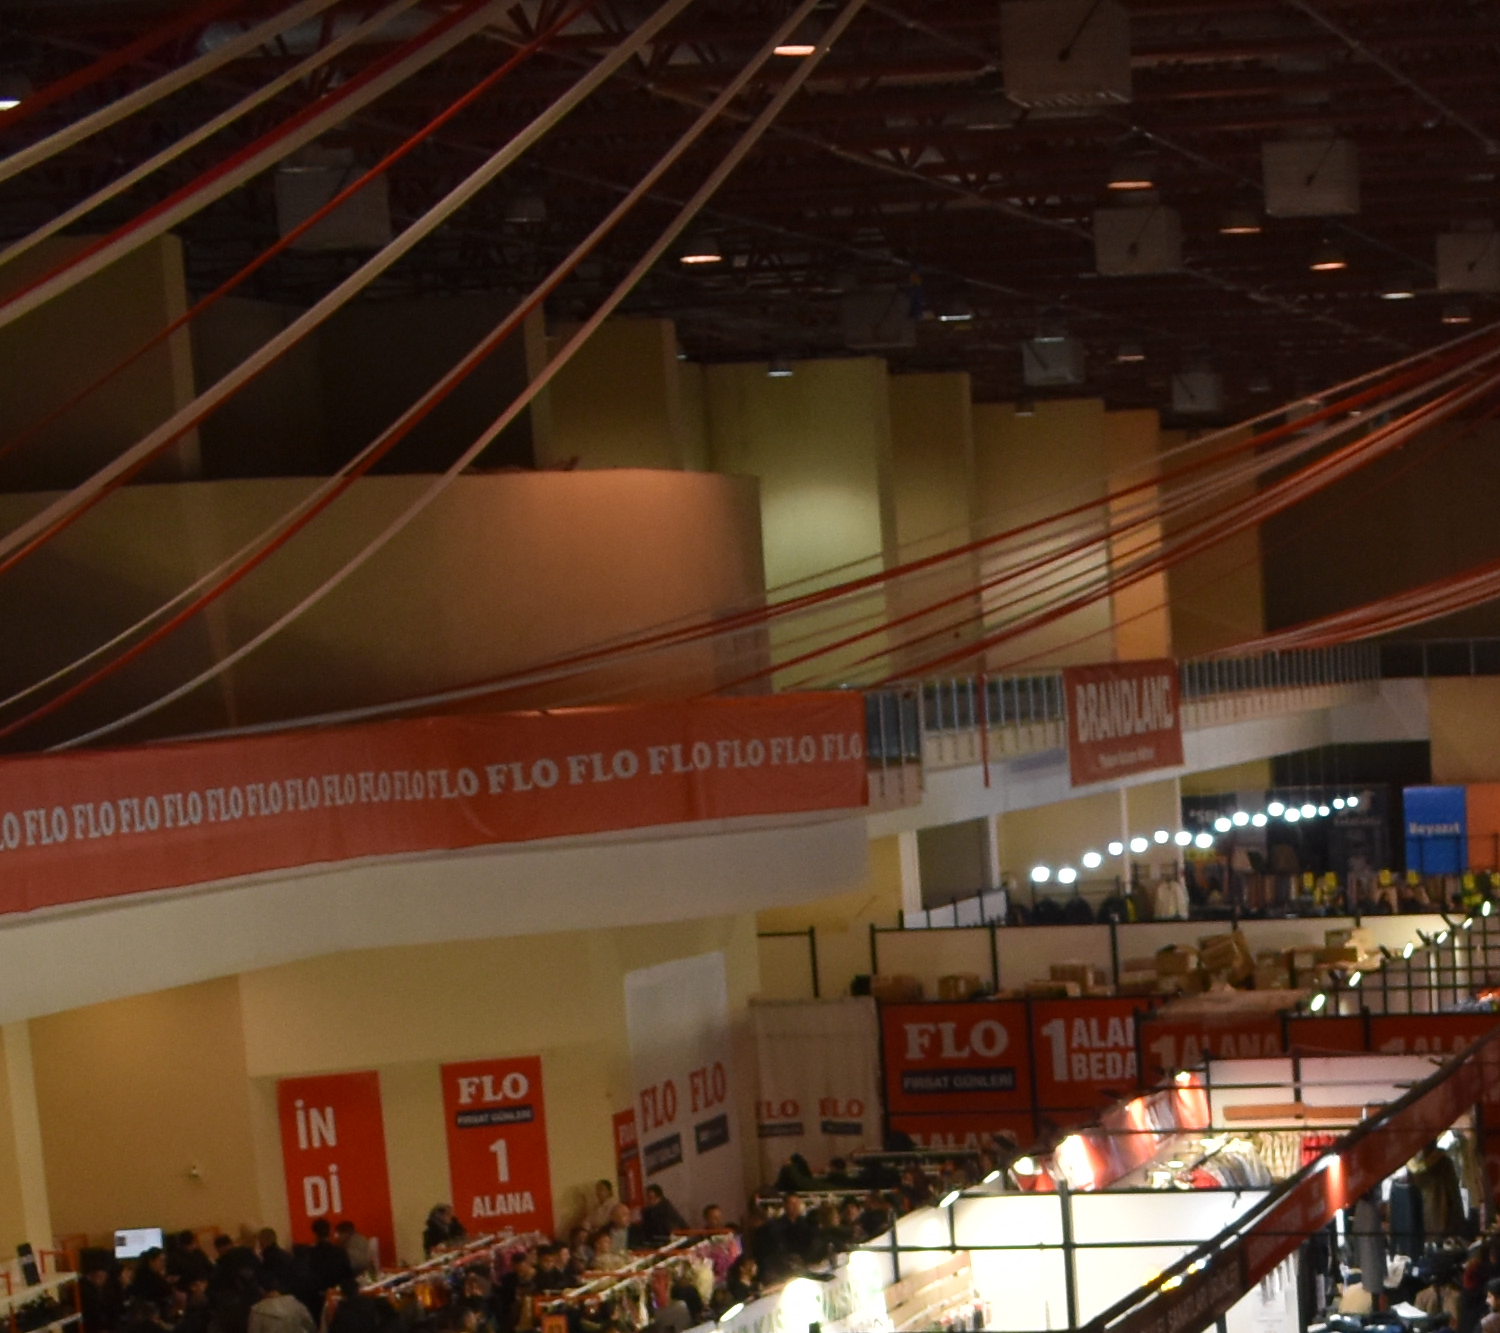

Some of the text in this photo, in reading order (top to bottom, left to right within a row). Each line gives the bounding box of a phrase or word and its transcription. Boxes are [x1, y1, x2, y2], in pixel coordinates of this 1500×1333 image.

[23, 806, 68, 846] FLO
[72, 800, 116, 840] FLO
[117, 794, 160, 834] FLO
[162, 789, 202, 829] FLO
[204, 785, 244, 823] FLO
[246, 781, 283, 817] FLO
[286, 776, 320, 812] FLO
[322, 772, 357, 807] FLO
[358, 769, 392, 802] FLO
[394, 767, 425, 802] FLO
[426, 763, 480, 800] FLO
[485, 758, 559, 796] FLO
[567, 749, 640, 786] FLO
[647, 741, 712, 776] FLO
[716, 738, 765, 769] FLO
[769, 734, 818, 767] FLO
[821, 732, 864, 763] FLO
[903, 1019, 1008, 1060] FLO
[458, 1072, 530, 1105] FLO
[640, 1079, 677, 1133] FLO
[689, 1062, 726, 1113] FLO
[819, 1098, 864, 1117] FLO
[295, 1099, 337, 1150] İN
[489, 1138, 510, 1183] 1
[472, 1191, 535, 1218] ALANA
